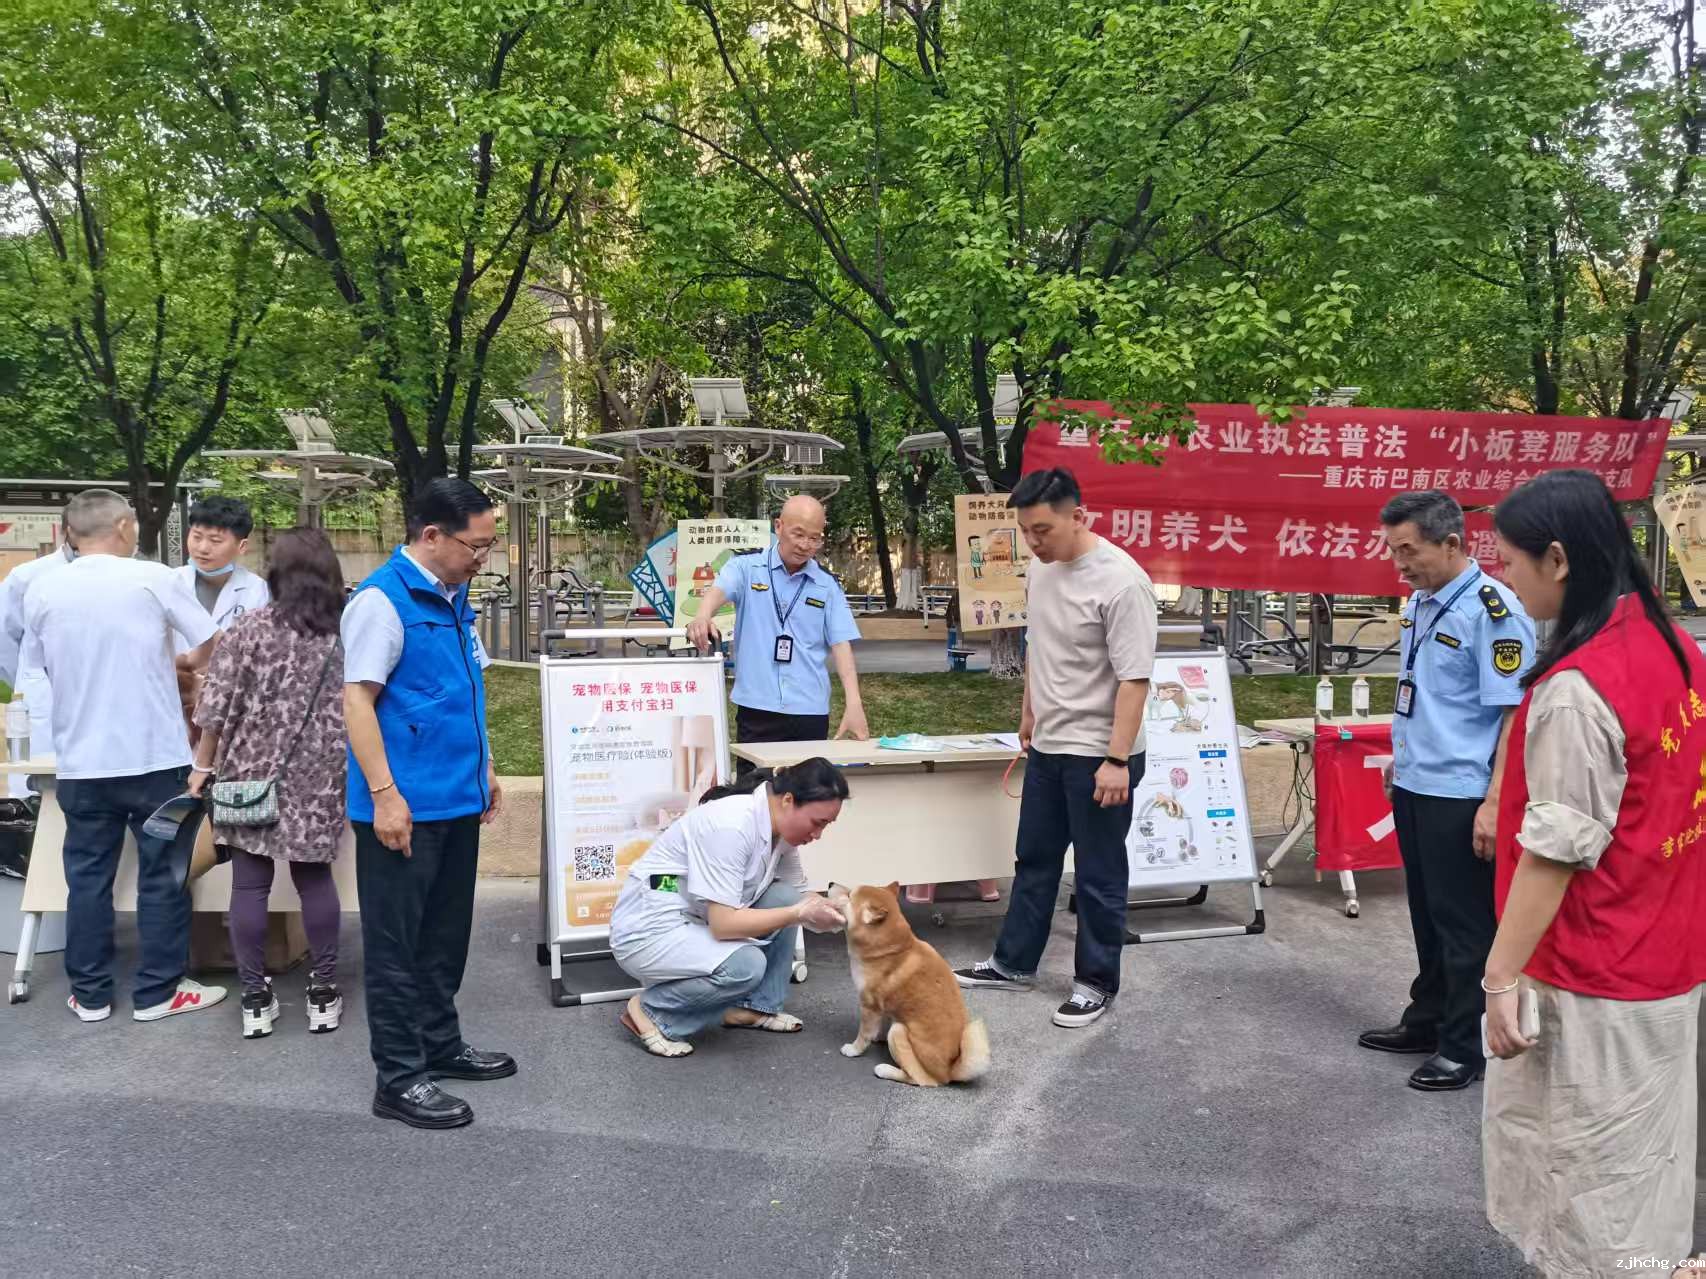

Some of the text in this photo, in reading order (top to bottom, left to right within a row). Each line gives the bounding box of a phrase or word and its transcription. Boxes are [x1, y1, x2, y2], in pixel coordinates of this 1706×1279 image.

[1275, 517, 1393, 561] 依法办
[572, 681, 698, 697] 宠物医保 宠物医保
[602, 699, 674, 712] 用支付宝扫
